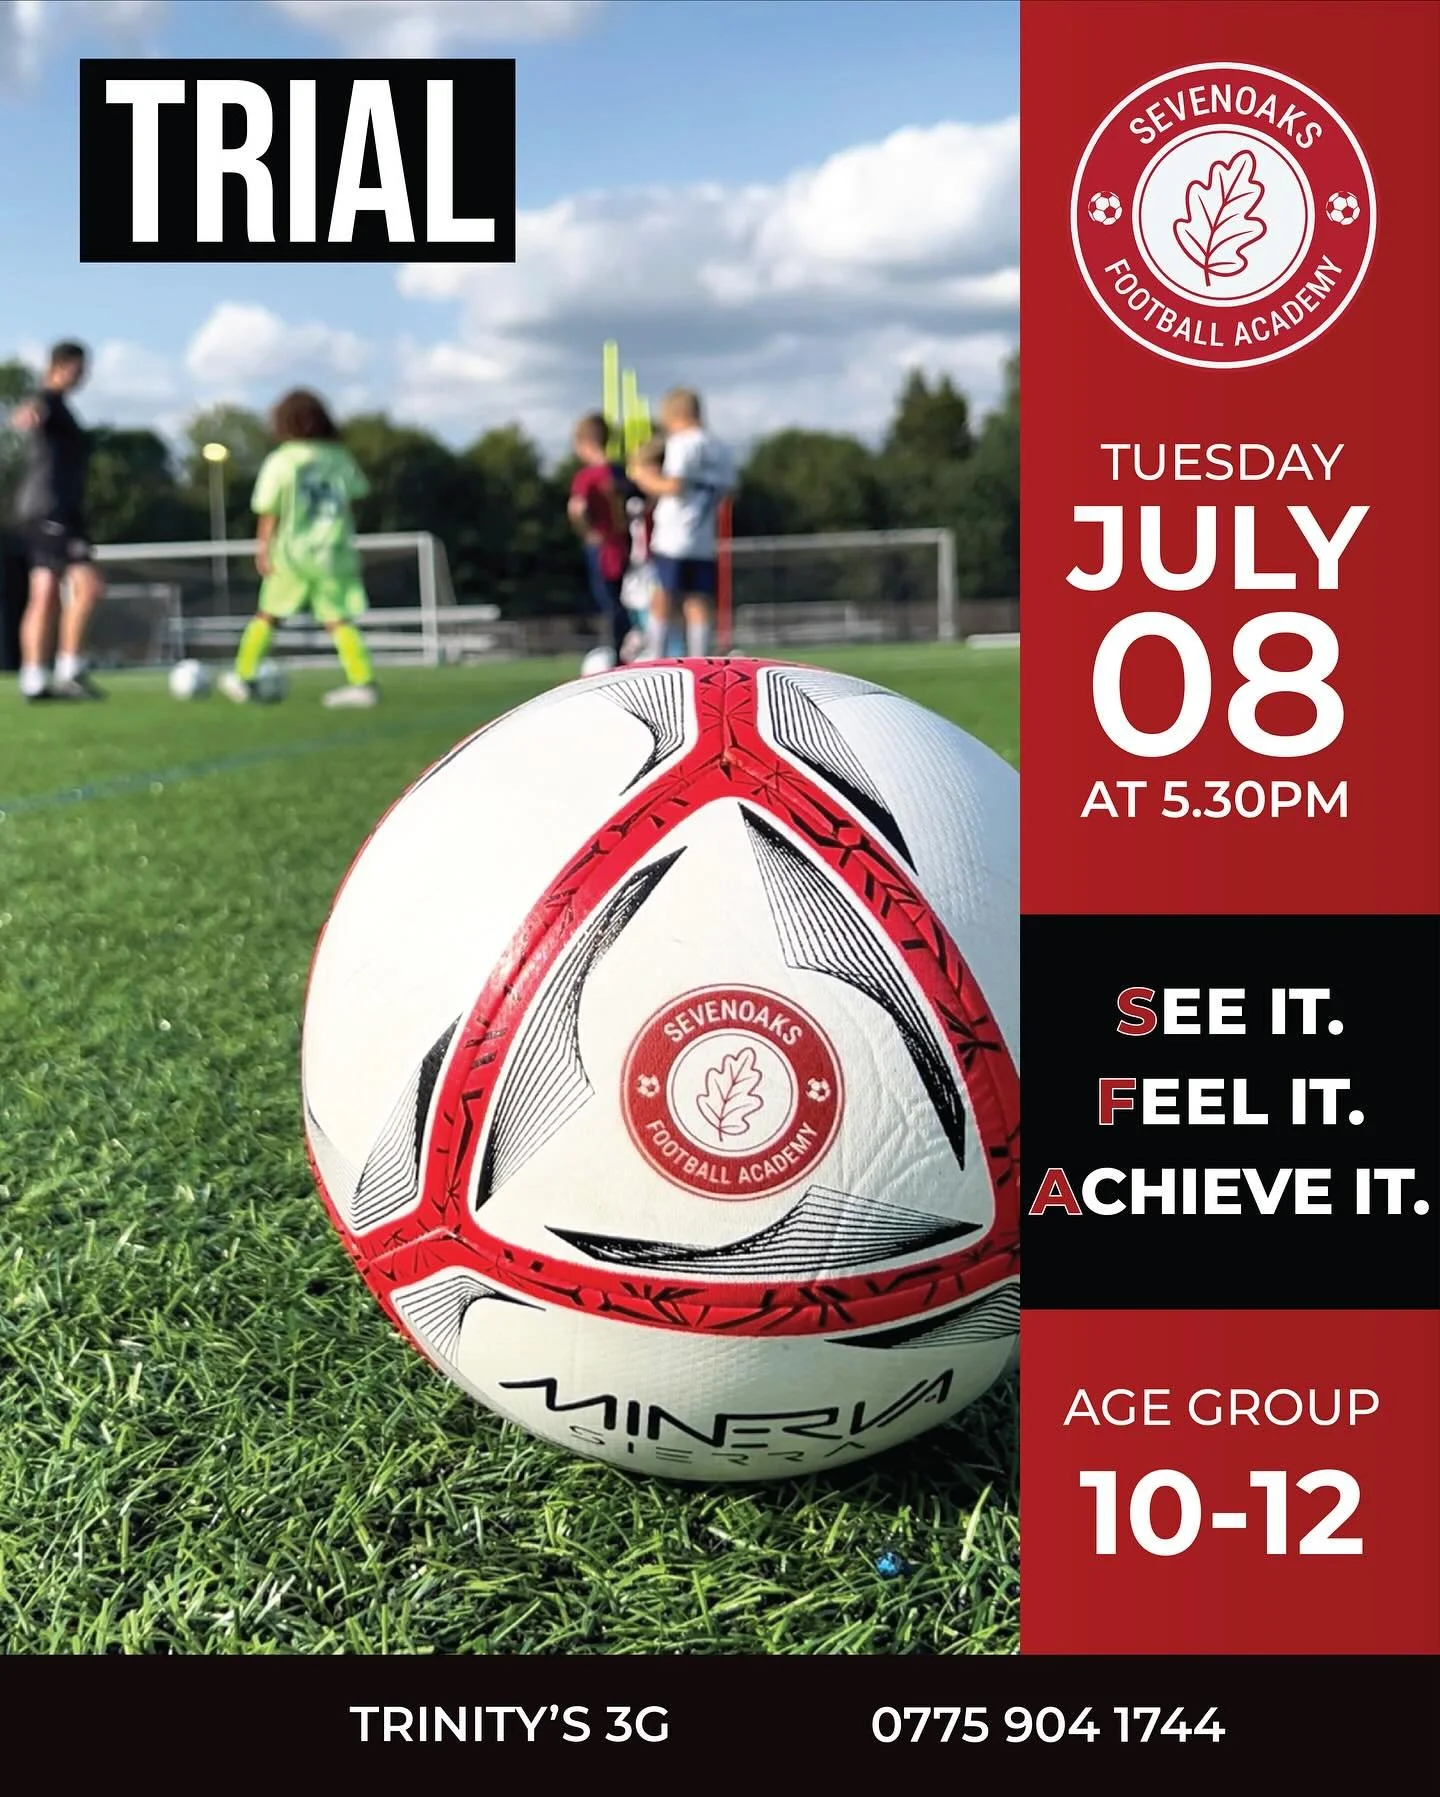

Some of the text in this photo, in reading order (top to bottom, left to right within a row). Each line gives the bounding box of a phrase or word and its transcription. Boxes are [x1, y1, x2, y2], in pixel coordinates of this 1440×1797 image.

[663, 999, 803, 1046] SEVENOAKS
[646, 1119, 818, 1185] FOOTBALL ACADEMY
[499, 1368, 954, 1448] MINERVA
[569, 1424, 866, 1466] SIERRA
